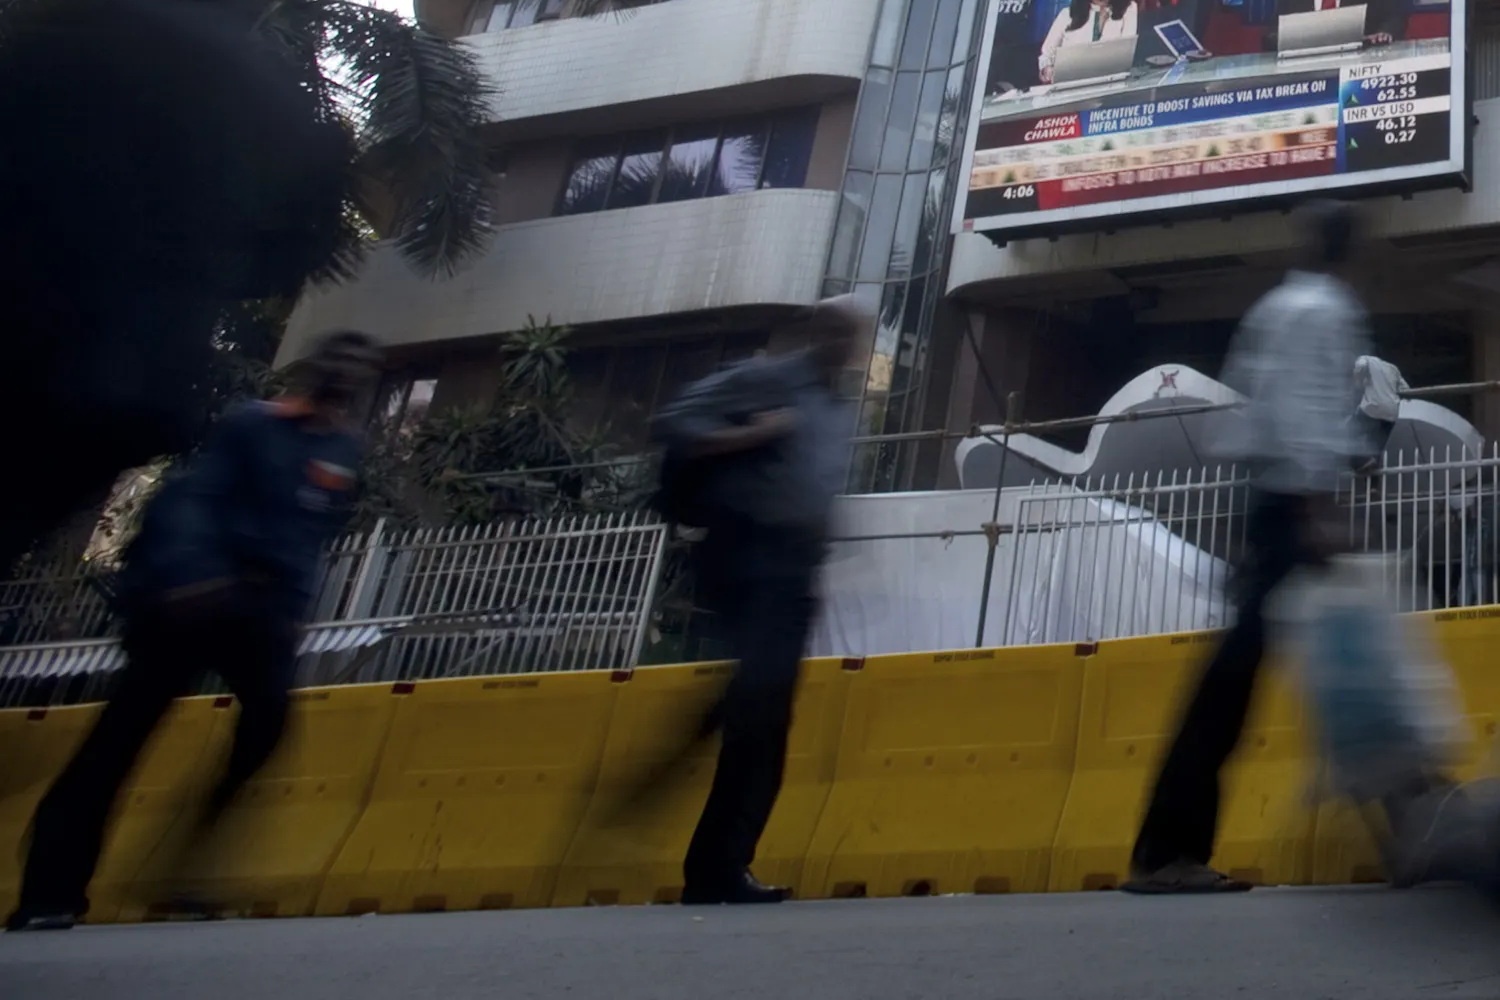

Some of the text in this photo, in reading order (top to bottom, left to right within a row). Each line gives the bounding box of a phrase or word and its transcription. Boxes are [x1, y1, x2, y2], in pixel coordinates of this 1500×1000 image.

[1349, 65, 1382, 78] NIFTY
[1361, 73, 1418, 90] 4922.30
[1089, 80, 1327, 121] INCENTIVE TO BOOST SAVINGS VIA TAX BREAK ON
[1377, 86, 1417, 102] 62.55
[1347, 103, 1415, 120] INR VS USD
[1035, 115, 1078, 130] ASHOK
[1088, 115, 1154, 134] INFRA BONDS
[1376, 116, 1417, 131] 46.12
[1024, 126, 1075, 142] CHAWLA
[1385, 130, 1416, 144] 0.27
[1003, 185, 1034, 200] 4:06
